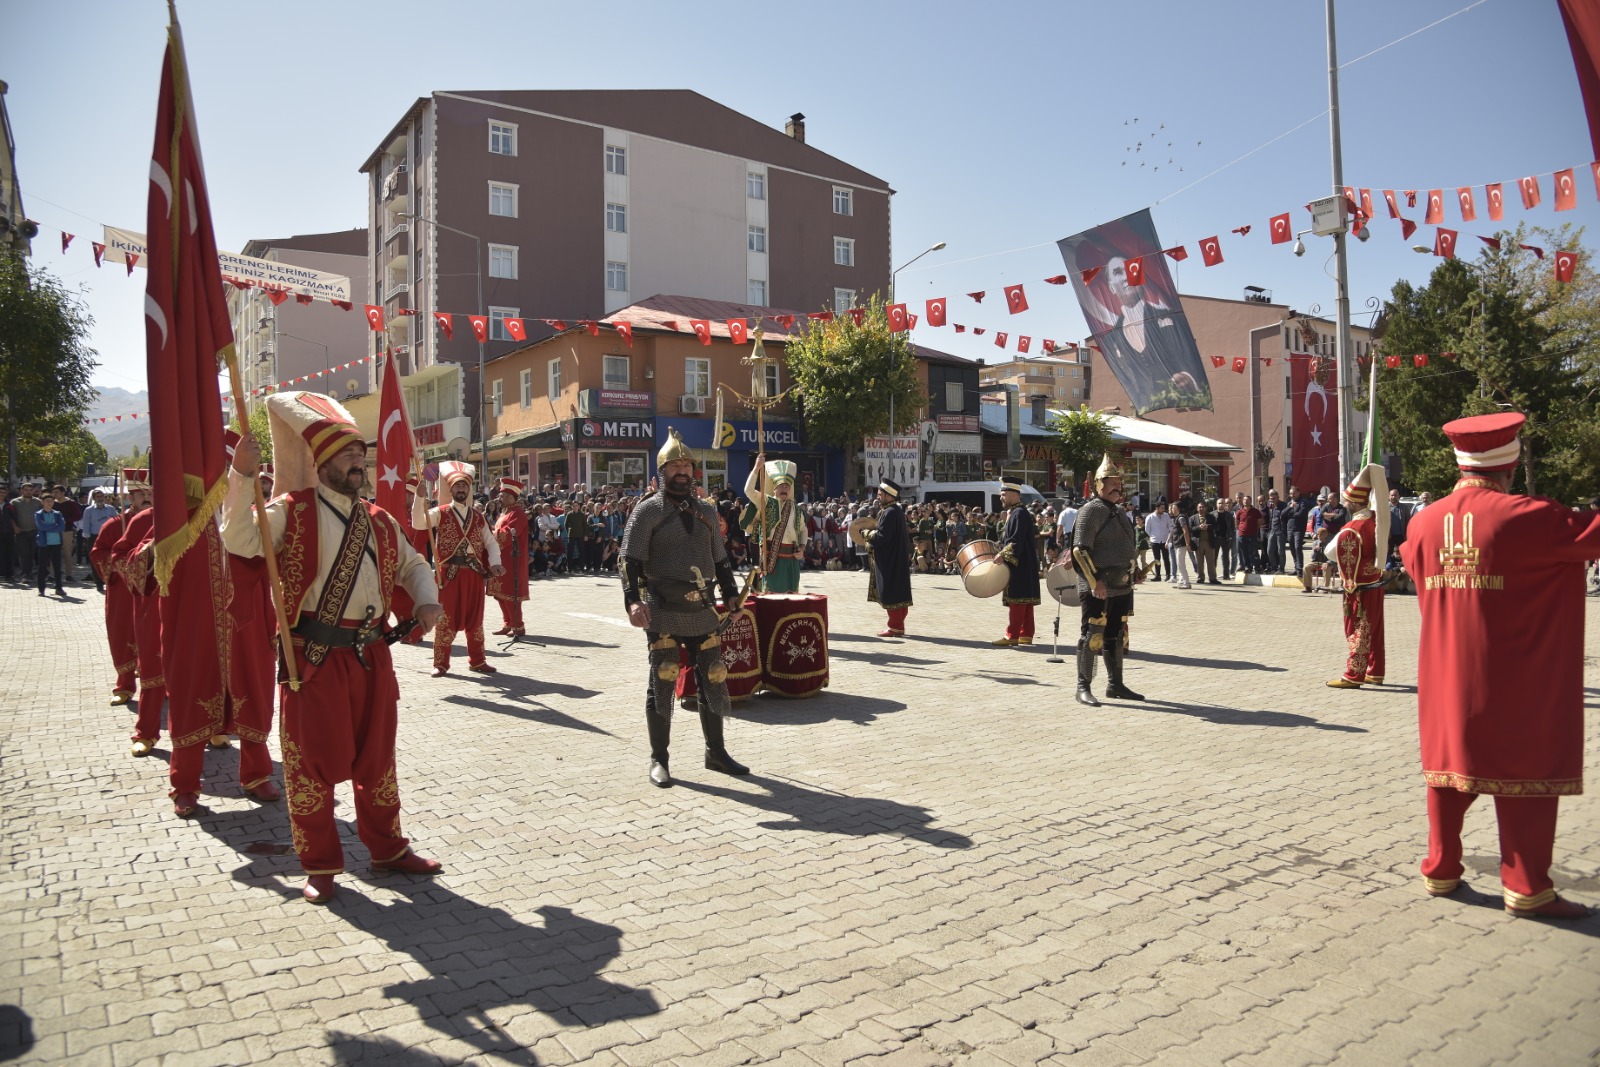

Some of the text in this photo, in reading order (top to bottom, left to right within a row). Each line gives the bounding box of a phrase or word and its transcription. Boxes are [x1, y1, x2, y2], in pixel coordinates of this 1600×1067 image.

[219, 254, 318, 280] ĞRENCİLERİMİZ
[269, 274, 344, 293] KAĞIZMAN'A
[740, 429, 799, 444] TUKCEL
[866, 438, 917, 449] TUTKNLAR
